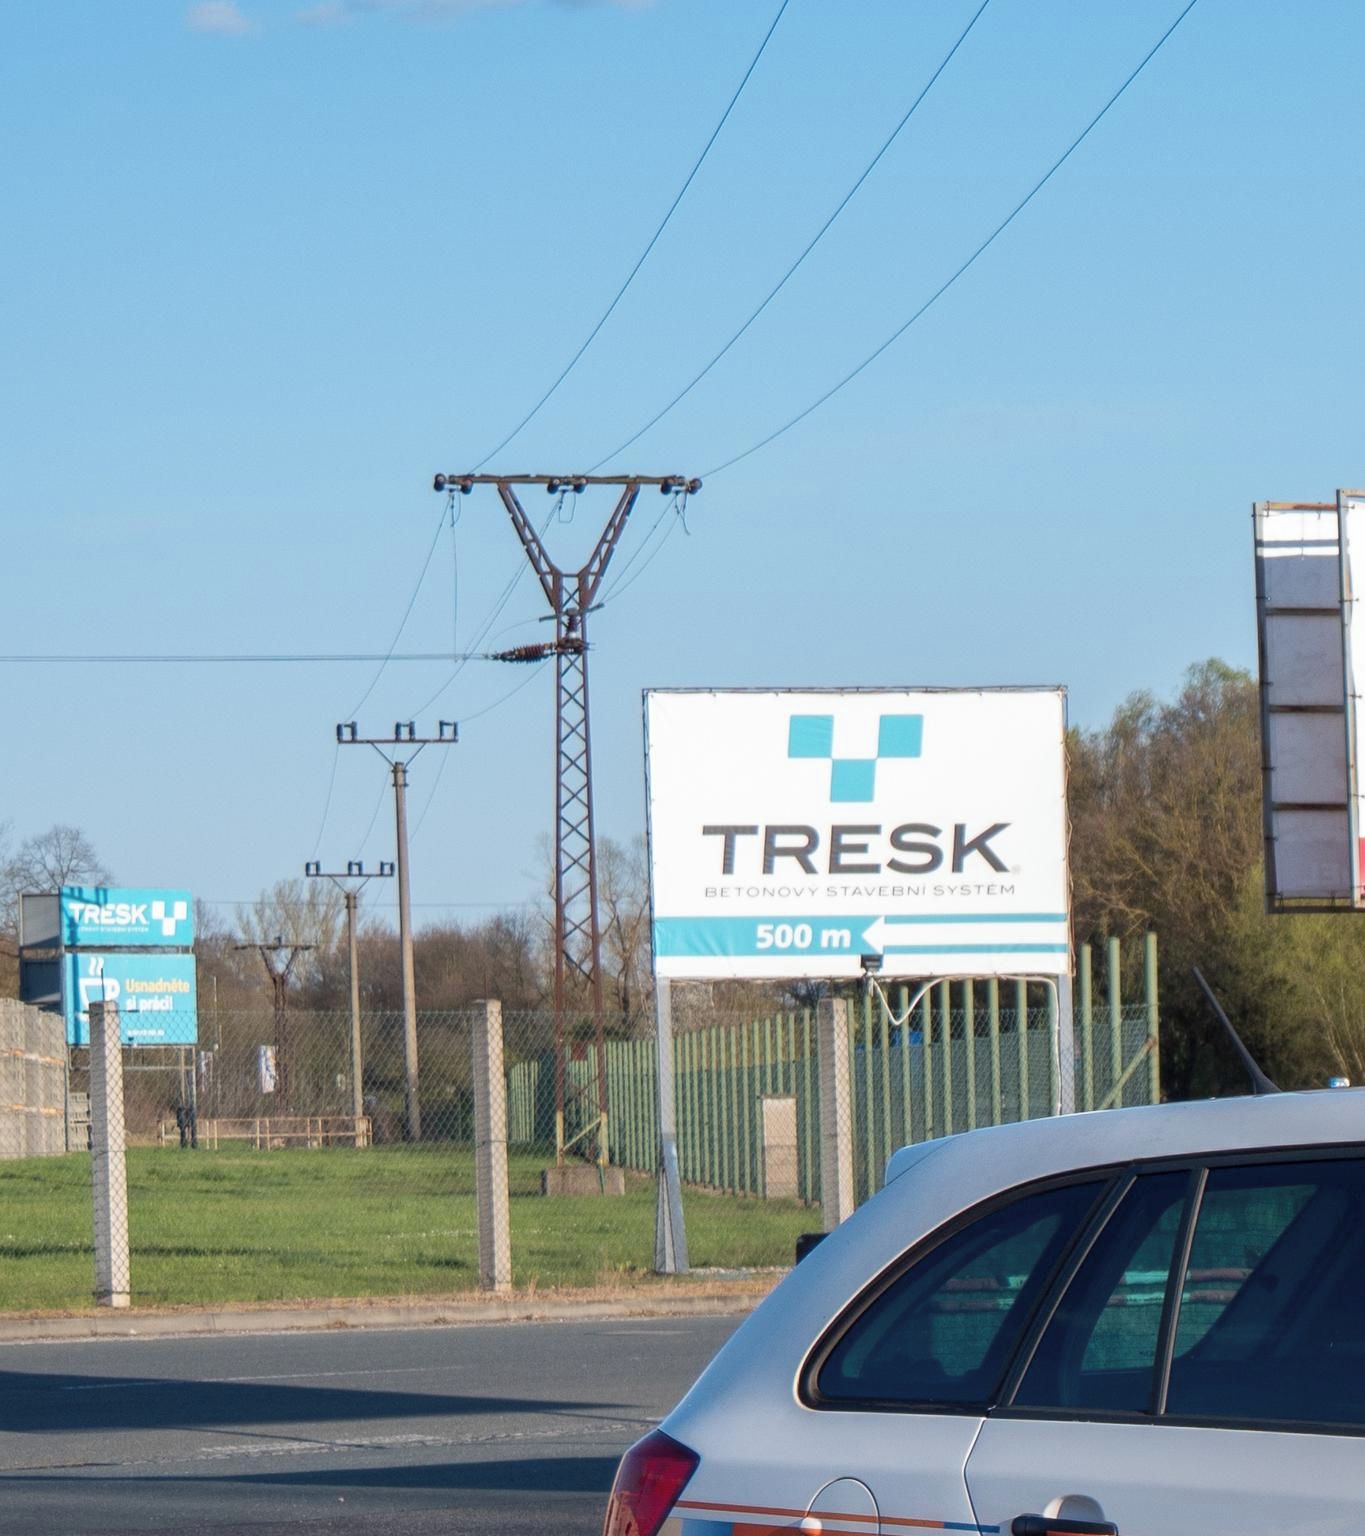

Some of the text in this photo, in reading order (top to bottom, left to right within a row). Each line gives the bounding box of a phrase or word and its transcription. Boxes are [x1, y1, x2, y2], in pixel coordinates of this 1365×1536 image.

[702, 823, 1011, 875] TRESK
[68, 902, 149, 925] TRESK
[756, 923, 851, 949] 500 m
